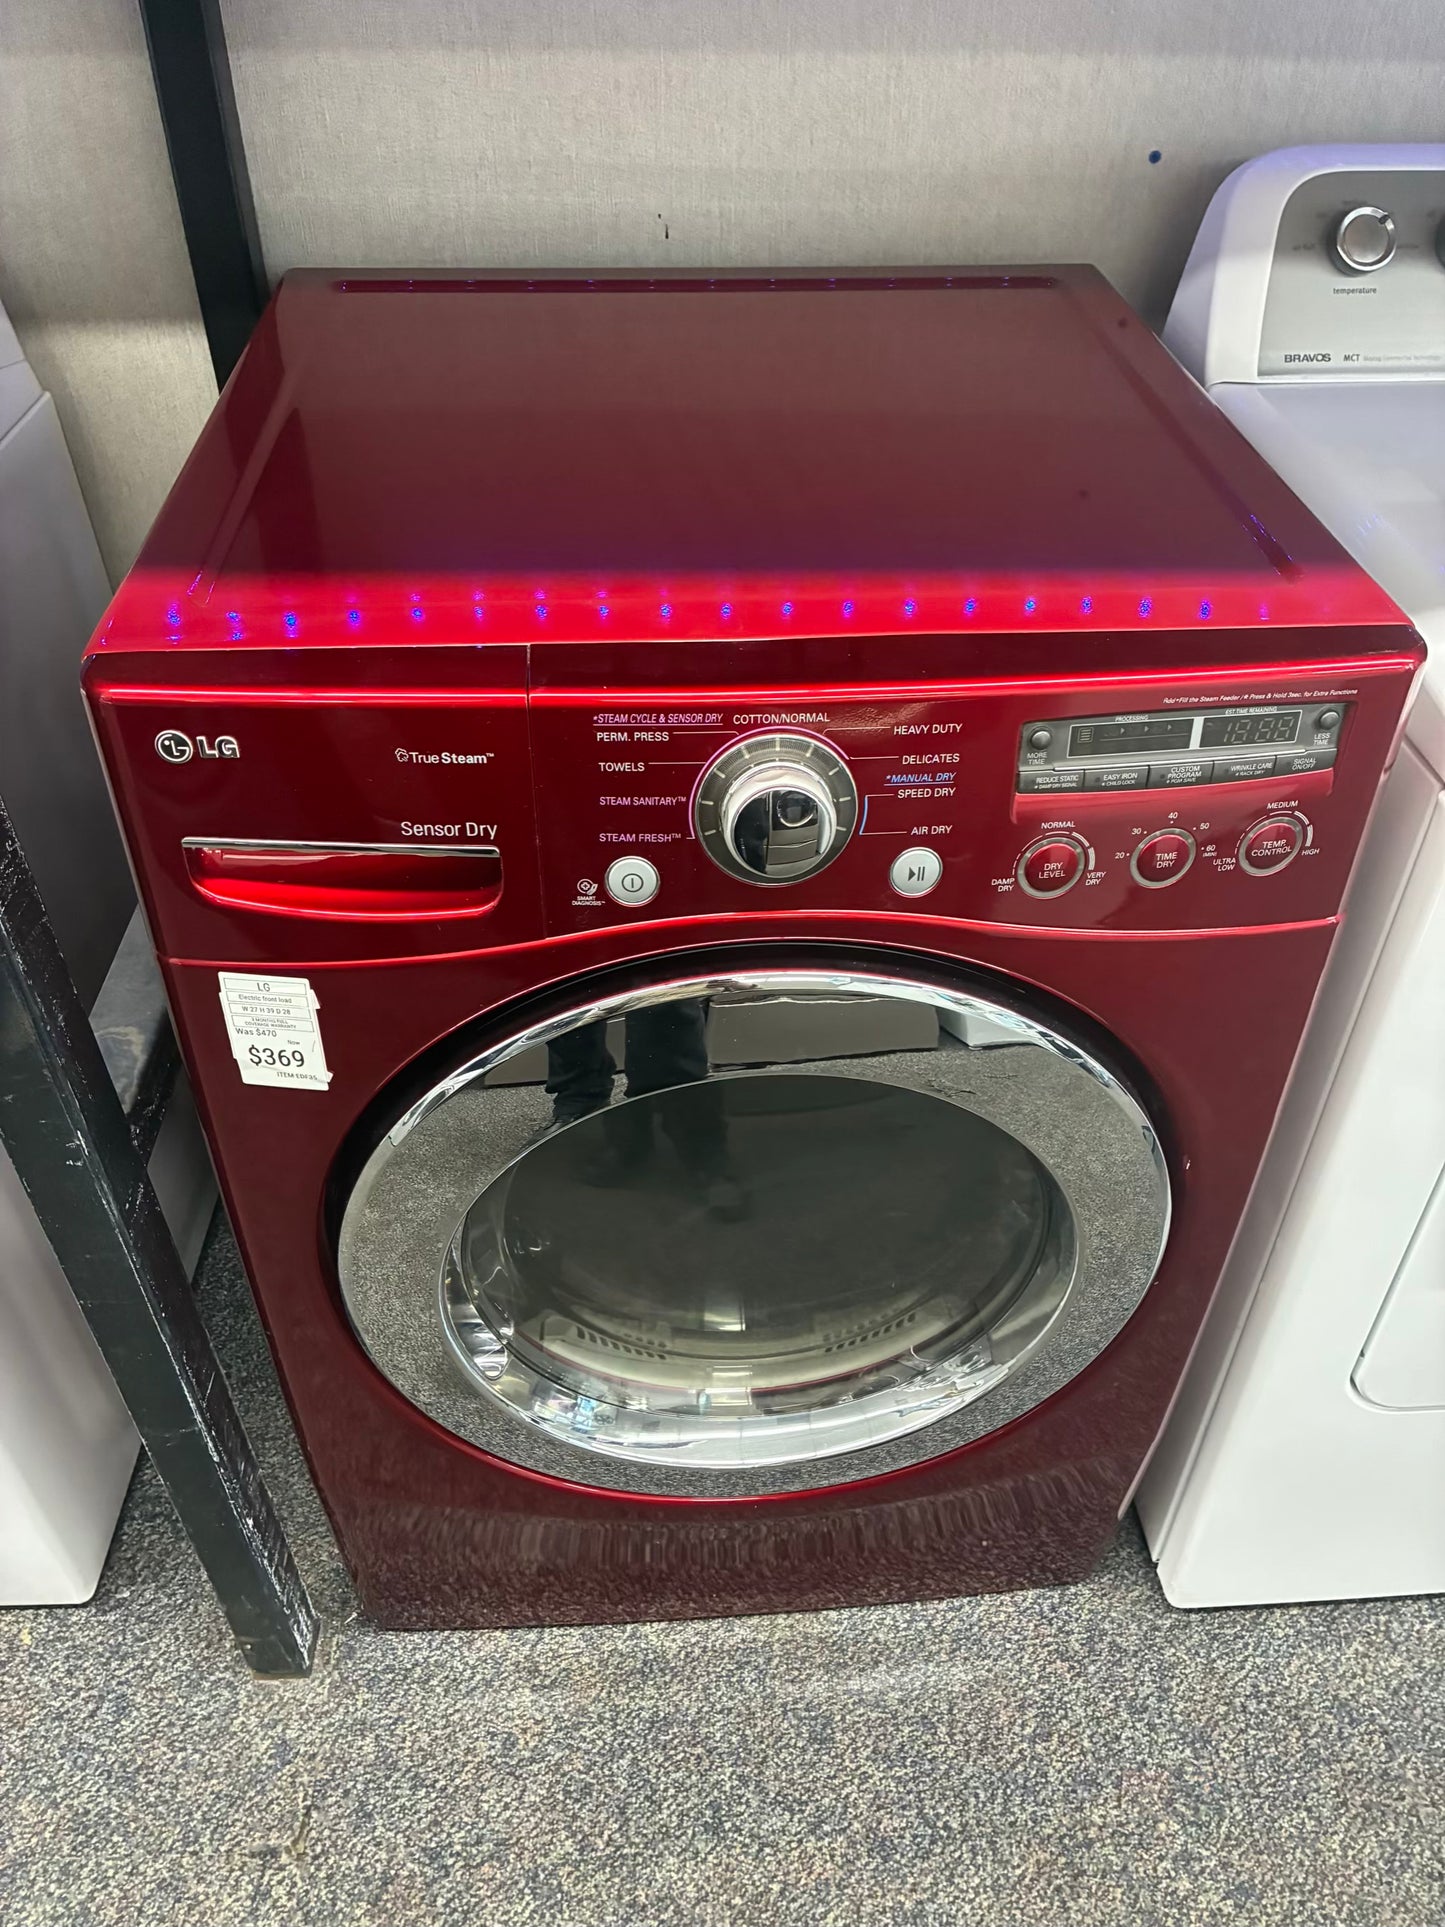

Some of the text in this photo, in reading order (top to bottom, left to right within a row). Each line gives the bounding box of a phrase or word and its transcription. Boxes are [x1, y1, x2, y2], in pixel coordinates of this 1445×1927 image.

[1333, 287, 1377, 296] temperature
[1284, 353, 1332, 363] BRAVOS
[1343, 353, 1361, 362] MCT
[1219, 694, 1240, 702] Feeder
[630, 713, 657, 724] CYCLE
[659, 713, 666, 724] &
[668, 713, 704, 724] SENSOR
[705, 713, 723, 723] DRY
[733, 712, 830, 725] COTTON/NORMAL
[893, 723, 963, 736] HEAVY DUTY
[596, 731, 669, 742] PERM. PRESS
[1313, 732, 1331, 740] LESS
[196, 735, 240, 758] LG
[1313, 738, 1329, 746] TIME
[902, 753, 960, 765] DELICATES
[598, 762, 645, 772] TOWELS
[1171, 765, 1201, 773] CUSTOM
[1230, 762, 1273, 771] WRINKLE CARE
[1292, 763, 1315, 771] ON/OFF
[935, 772, 957, 782] DRY
[1036, 774, 1079, 784] REDUCE STATIC
[1103, 772, 1138, 781] EASY IRON
[1167, 771, 1202, 779] PROGRAM
[897, 787, 956, 799] SPEED DRY
[599, 796, 631, 806] STEAM
[1266, 800, 1299, 809] MEDIUM
[1040, 821, 1076, 830] NORMAL
[400, 821, 498, 840] Sensor Dry
[911, 825, 953, 836] AIR DRY
[599, 833, 636, 843] STEAM
[1251, 846, 1293, 857] CONTROL
[1301, 848, 1320, 856] HIGH
[1155, 852, 1178, 861] TIME
[1156, 860, 1175, 869] DRY
[1213, 857, 1237, 866] ULTRA
[1044, 862, 1063, 871] DRY
[1217, 864, 1236, 872] LOW
[1038, 870, 1066, 879] LEVEL
[1086, 871, 1107, 879] VERY
[991, 877, 1015, 886] DAMP
[1085, 878, 1102, 887] DRY
[997, 885, 1015, 893] DRY
[256, 982, 271, 992] LG
[238, 993, 292, 1004] Electric front load
[234, 1027, 277, 1038] Was $470
[248, 1044, 305, 1068] $369
[276, 1071, 294, 1079] ITEM
